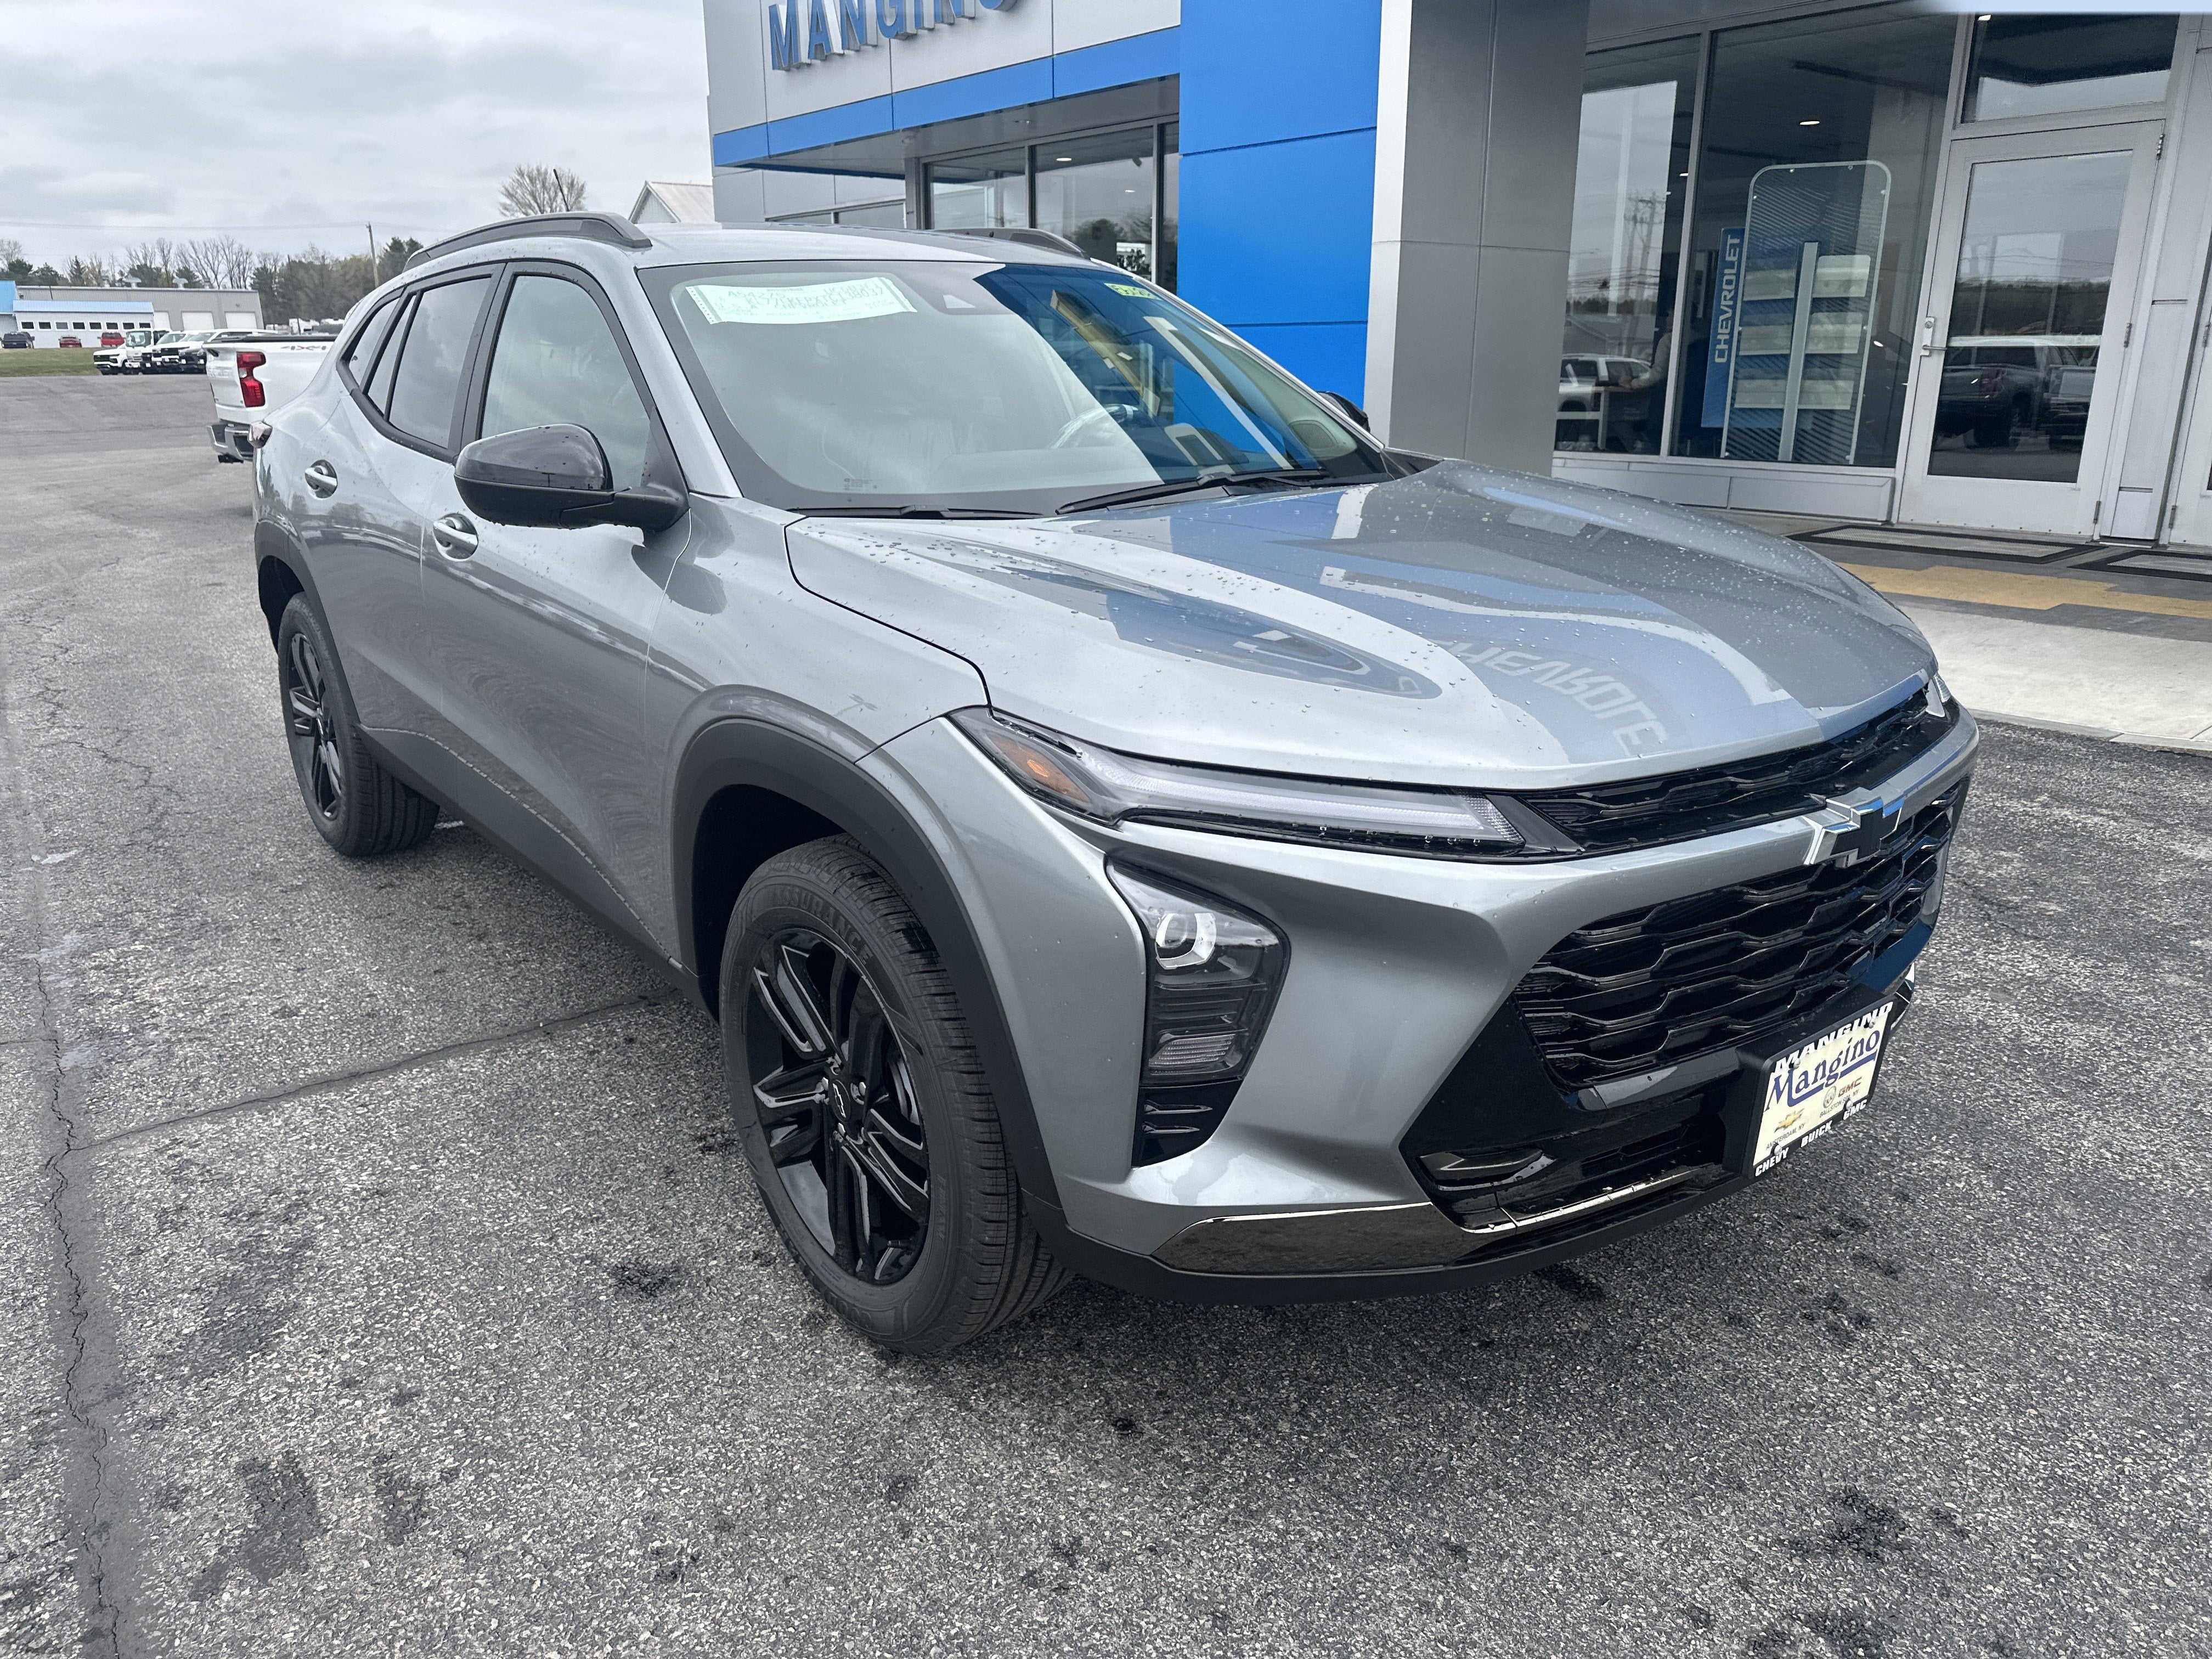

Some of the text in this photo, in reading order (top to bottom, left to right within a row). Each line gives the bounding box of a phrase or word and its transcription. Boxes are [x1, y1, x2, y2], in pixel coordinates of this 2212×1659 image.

[768, 0, 1011, 71] MANG
[1714, 234, 1740, 363] CHEVROLET
[1763, 1030, 1881, 1113] Mangino
[1771, 1001, 1893, 1073] MANGINO
[1838, 1076, 1863, 1098] GMC
[1755, 1099, 1867, 1177] CHEVY BUICK GMC
